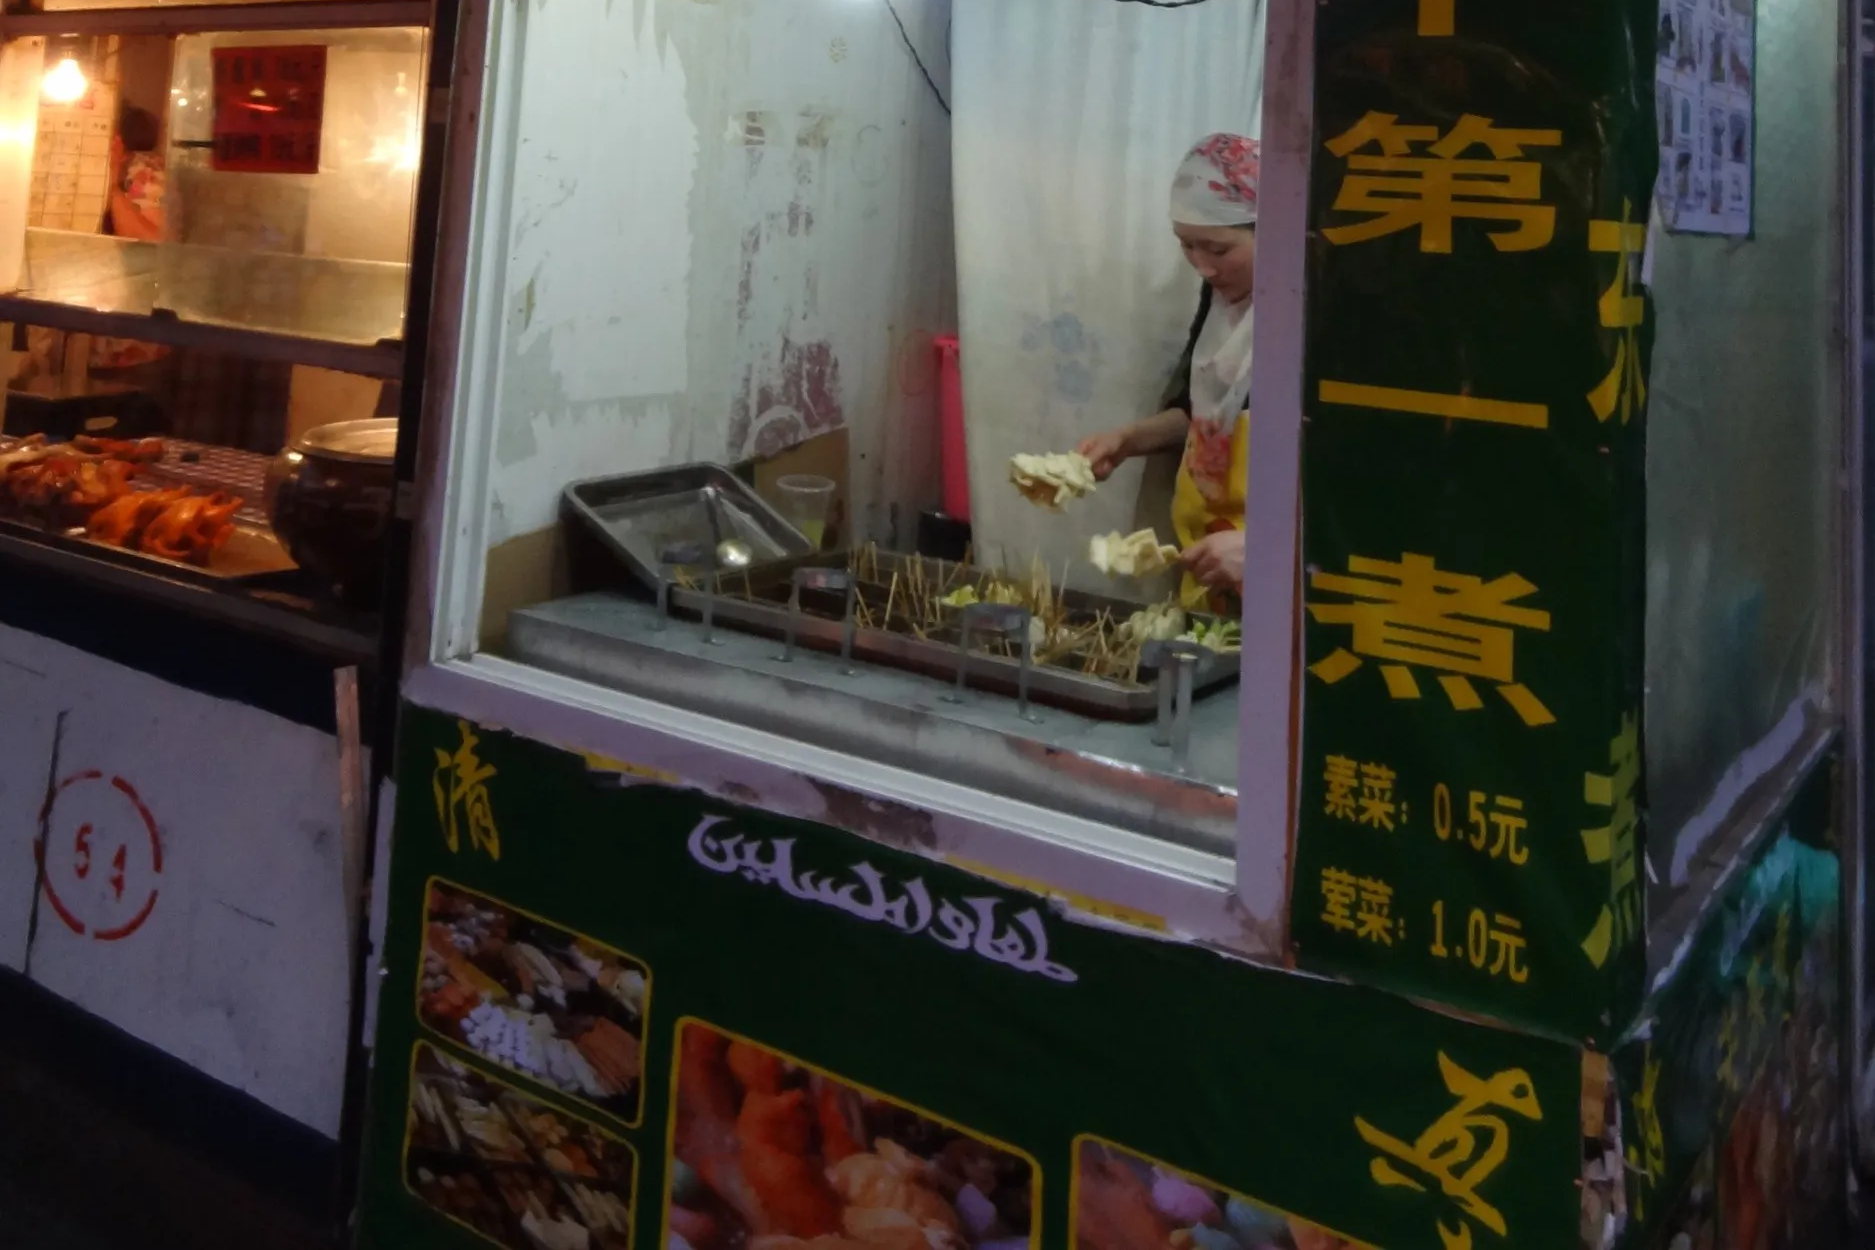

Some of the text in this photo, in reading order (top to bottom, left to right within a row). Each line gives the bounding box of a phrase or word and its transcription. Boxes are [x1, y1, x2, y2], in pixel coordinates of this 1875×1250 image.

[432, 719, 502, 862] 清
[1432, 781, 1531, 866] 0.5元
[1429, 899, 1530, 984] 1.0元
